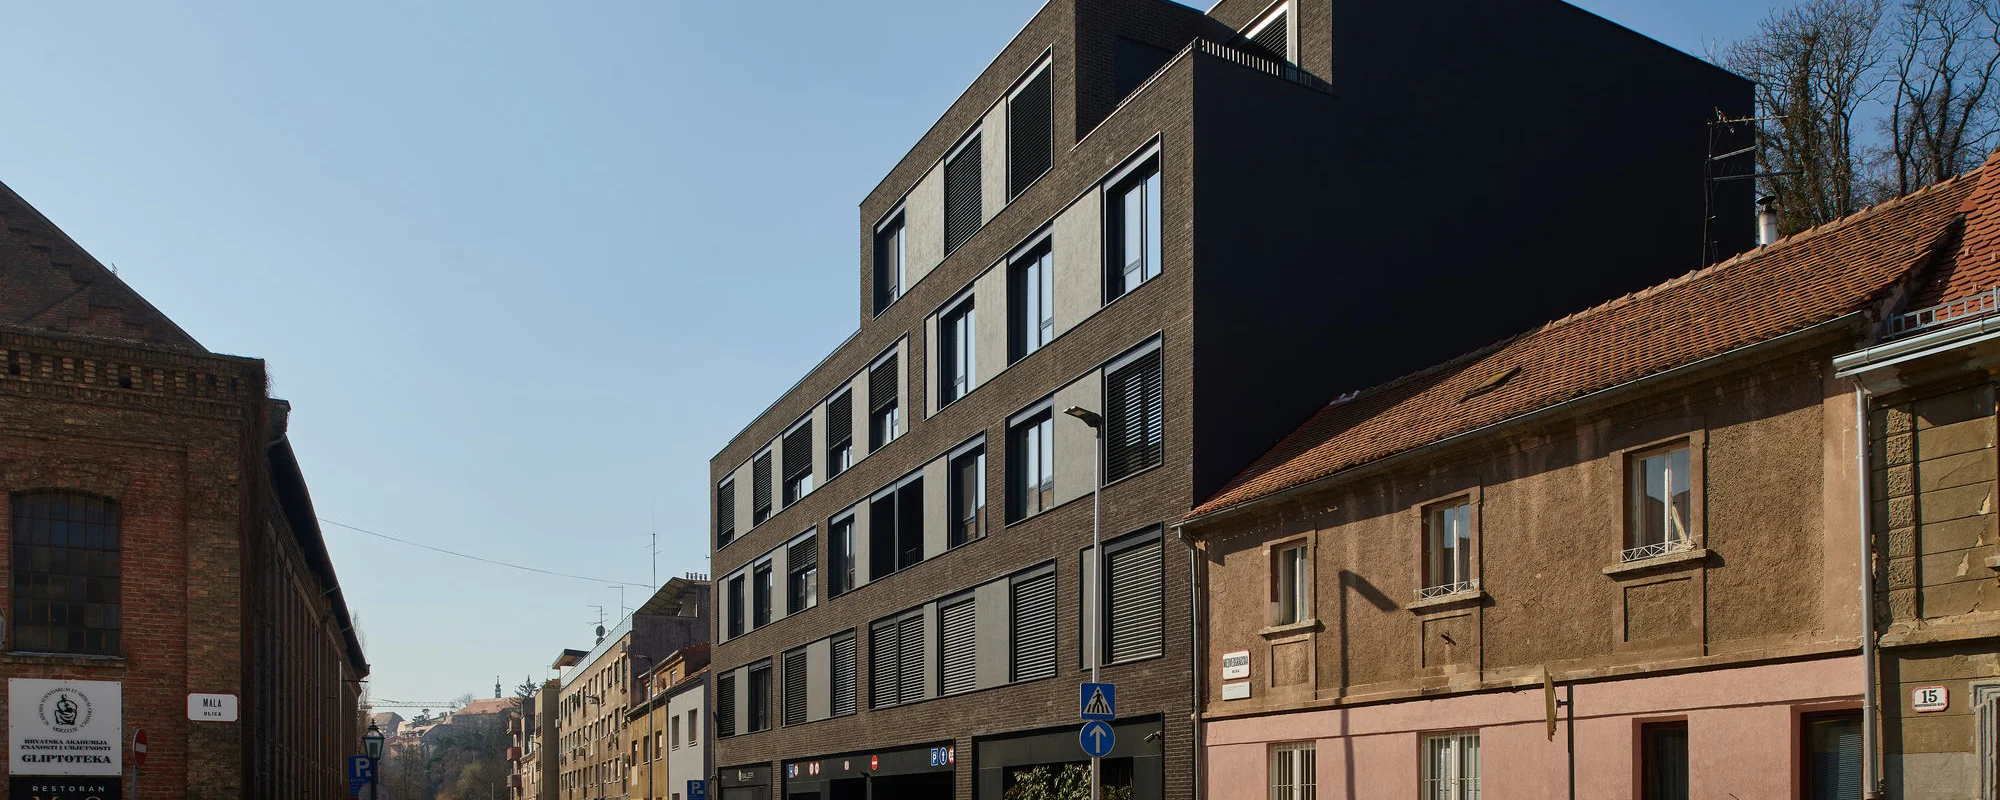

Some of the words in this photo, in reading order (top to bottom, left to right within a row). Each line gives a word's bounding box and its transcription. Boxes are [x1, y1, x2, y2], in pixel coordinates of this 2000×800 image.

[203, 698, 222, 708] MALA
[1922, 689, 1938, 704] 15
[21, 754, 112, 764] GLIPTOTEKA
[355, 757, 370, 777] P
[691, 781, 701, 795] P
